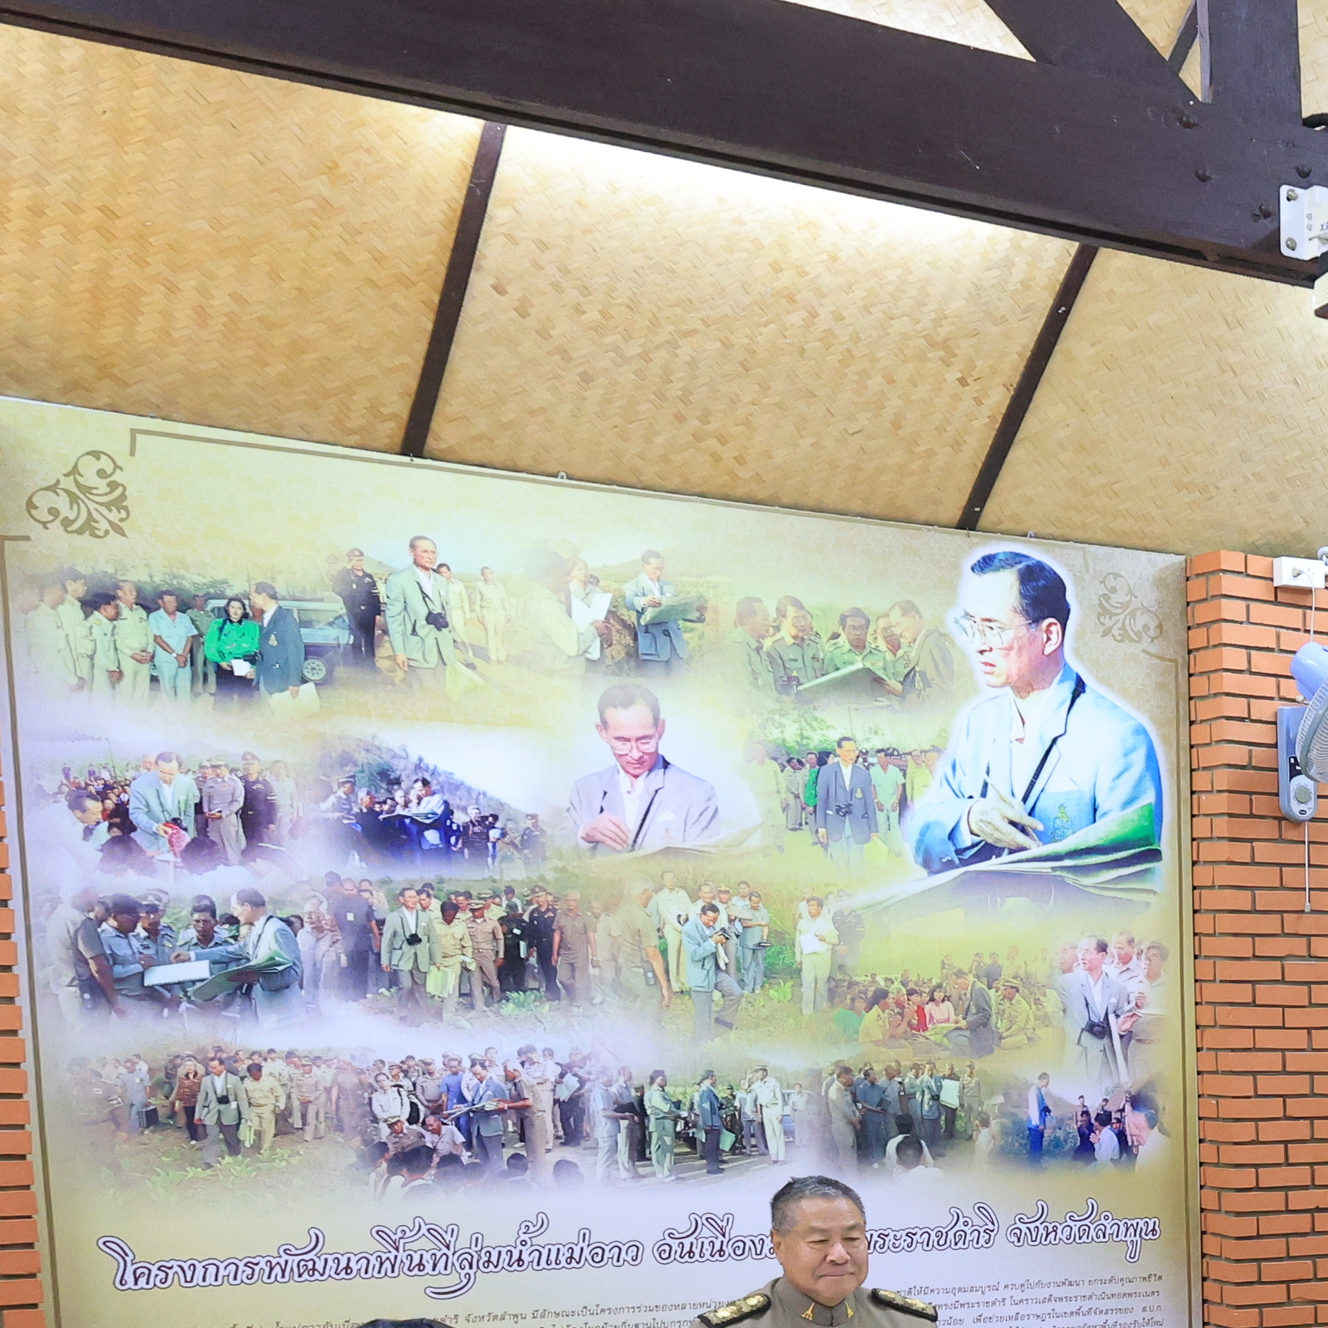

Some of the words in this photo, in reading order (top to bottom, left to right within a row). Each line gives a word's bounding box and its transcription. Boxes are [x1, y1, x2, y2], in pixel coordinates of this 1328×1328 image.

[98, 1212, 645, 1300] โครงการพัฒนาพื้นที่ลุ่มน้ำแม่อาว
[652, 1212, 776, 1266] อันเนื่อง
[1006, 1197, 1162, 1263] จังหวัดลำพูน
